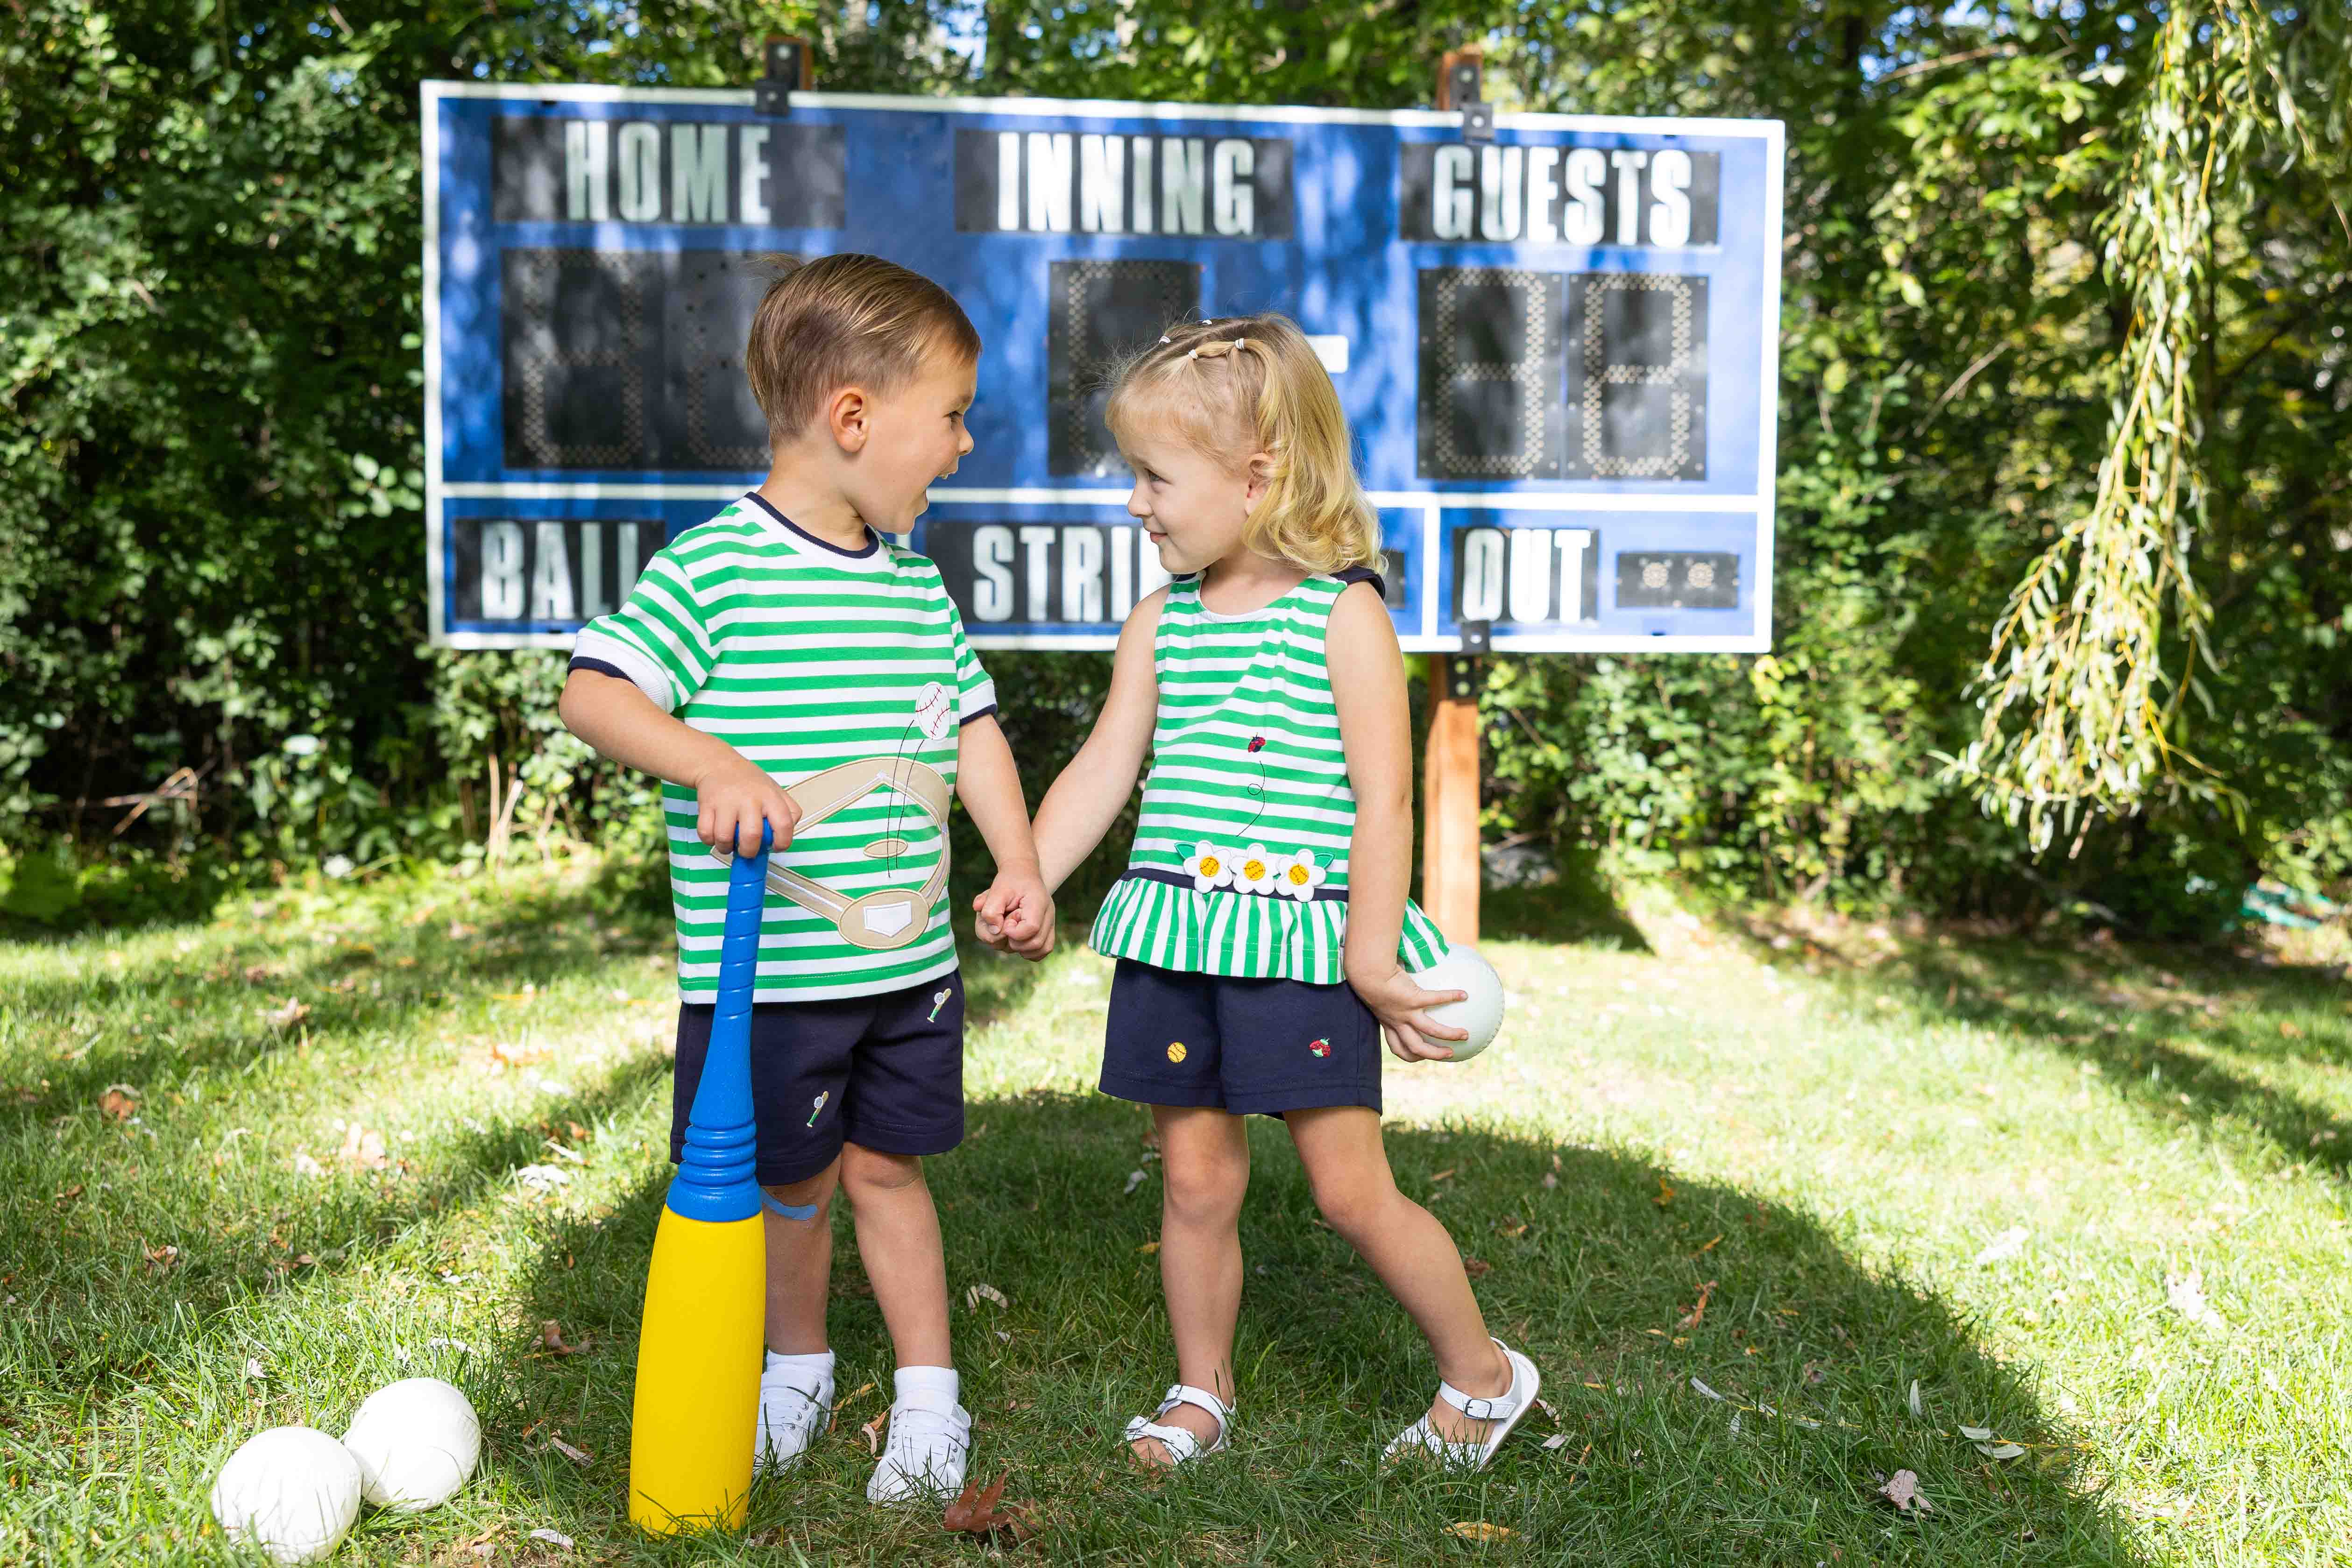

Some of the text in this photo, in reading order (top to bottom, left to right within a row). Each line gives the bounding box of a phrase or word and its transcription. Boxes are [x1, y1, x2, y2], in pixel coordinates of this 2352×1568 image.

[565, 120, 771, 225] HOME
[998, 132, 1254, 235] INNING
[1432, 145, 1692, 247] GUESTS
[1462, 528, 1592, 623] OUT
